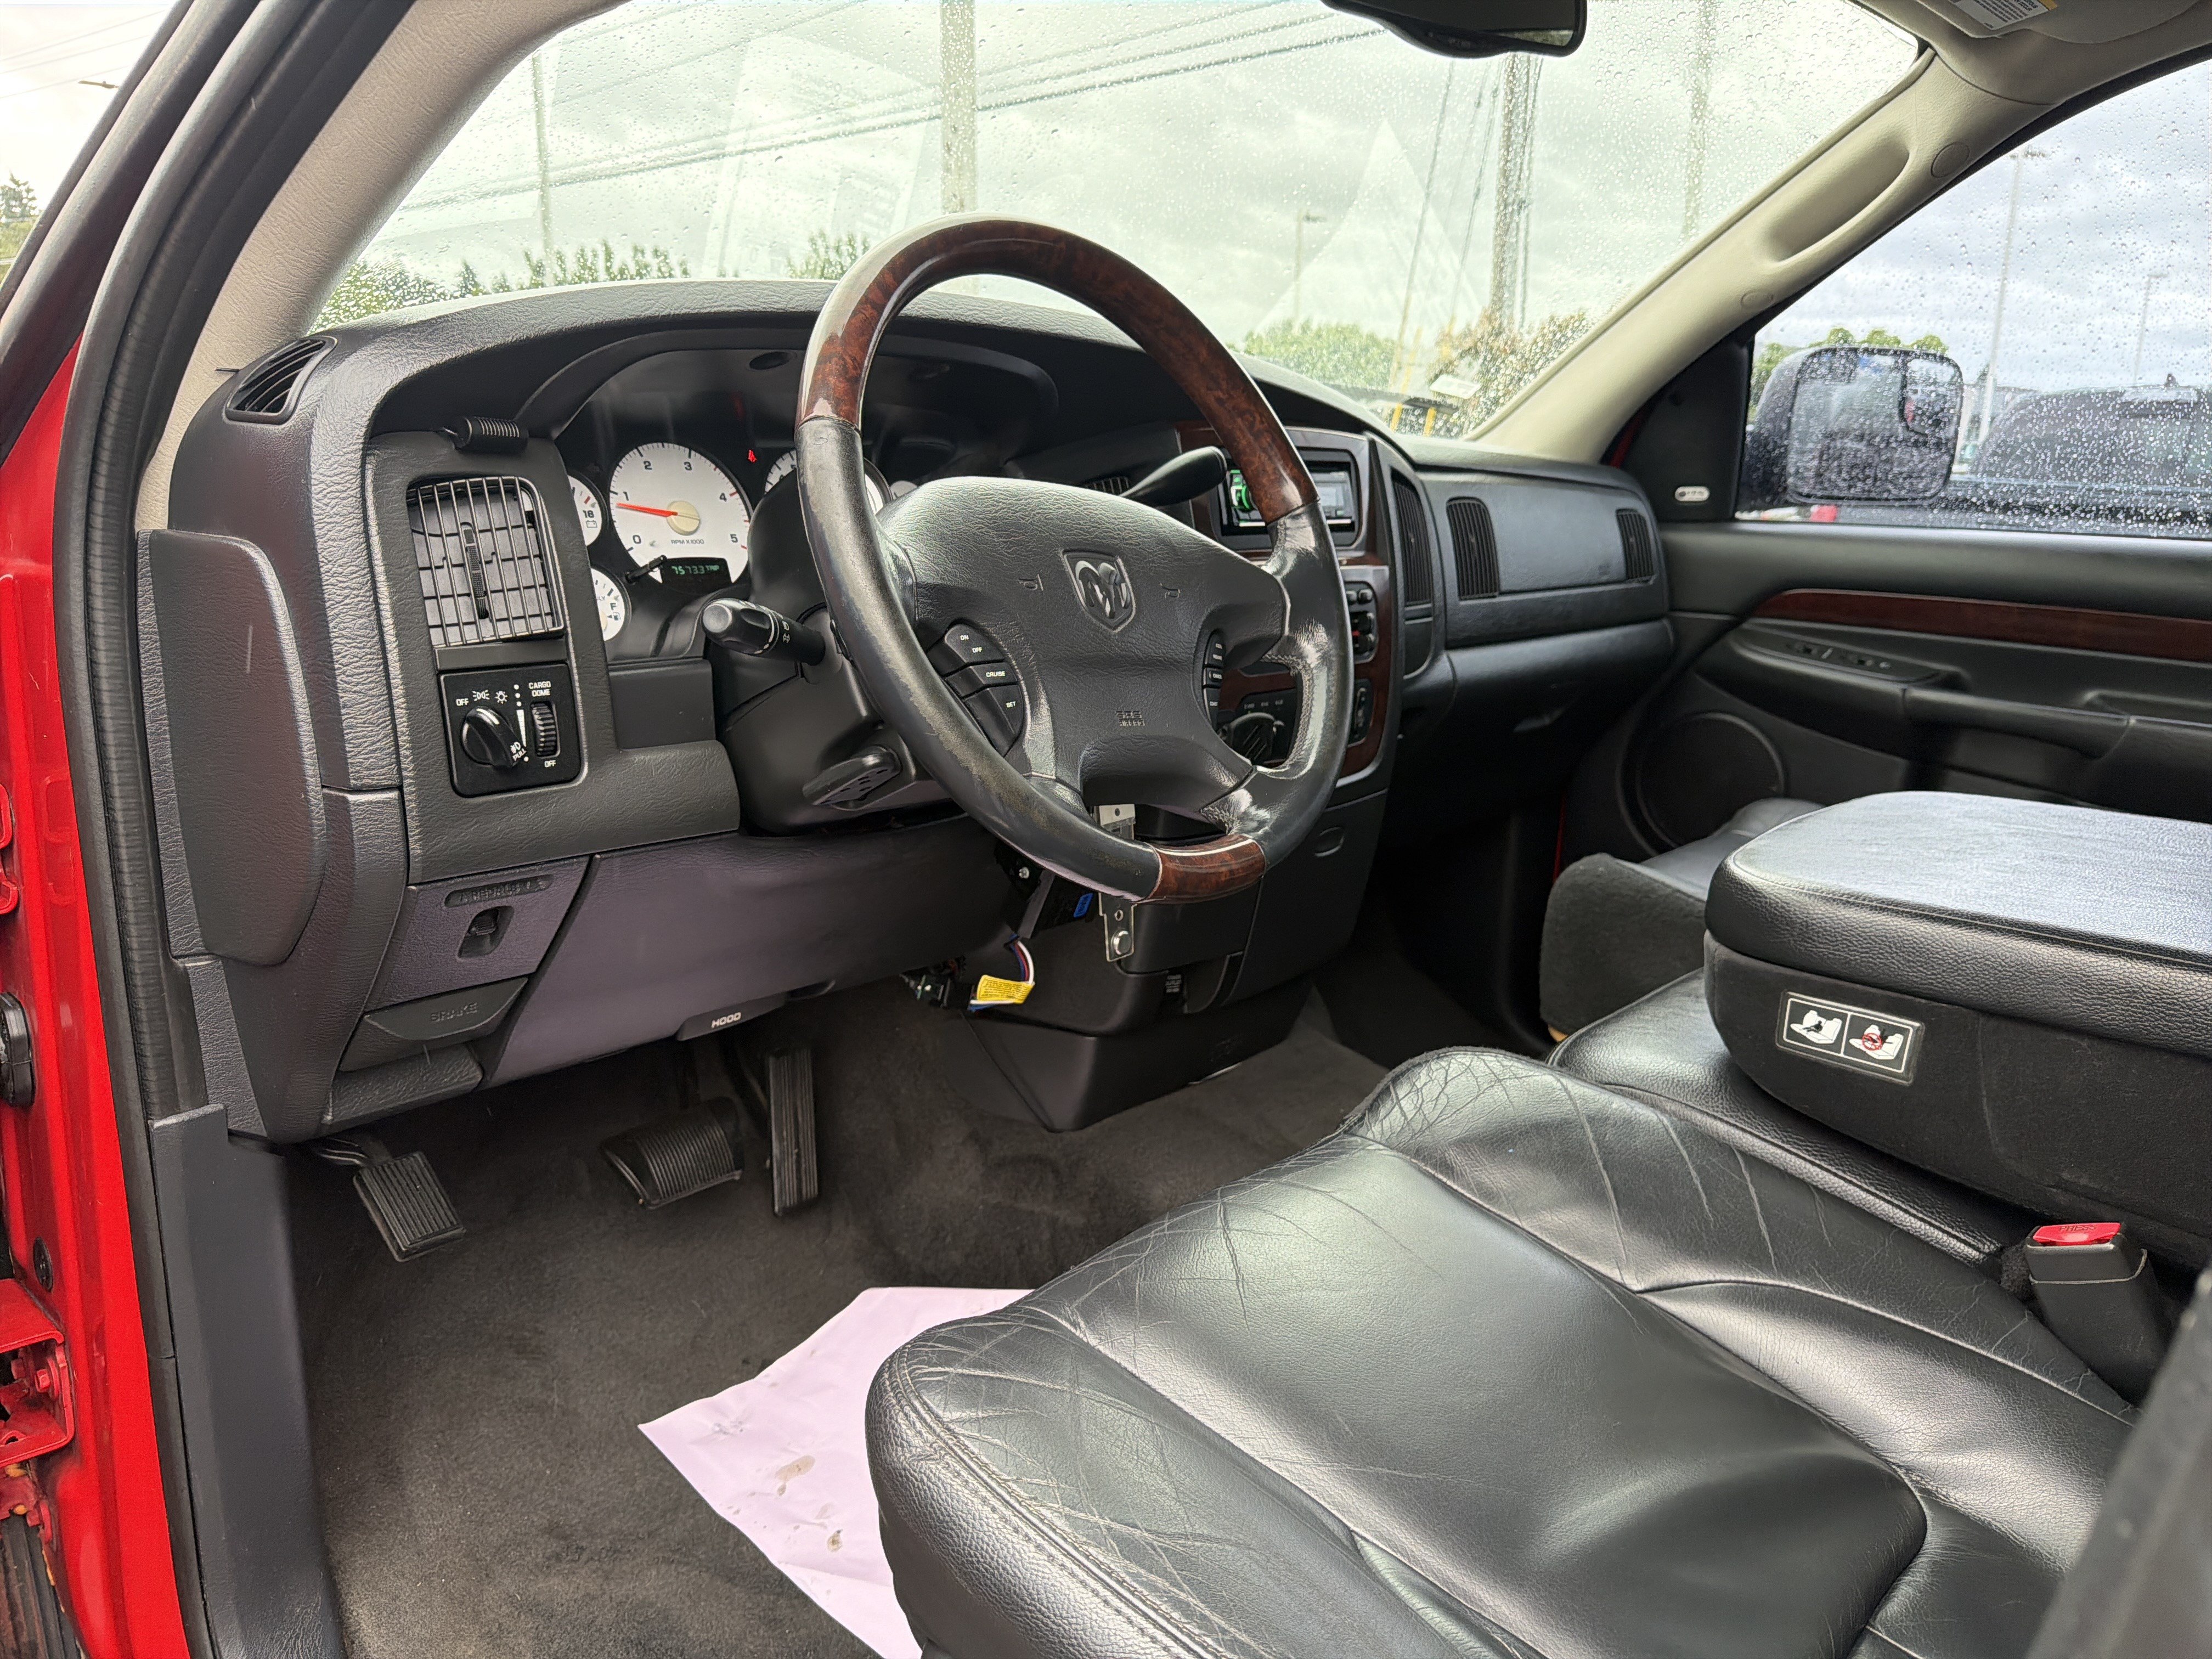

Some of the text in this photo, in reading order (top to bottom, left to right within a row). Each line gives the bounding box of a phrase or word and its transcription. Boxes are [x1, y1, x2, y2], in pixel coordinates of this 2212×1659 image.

[644, 461, 652, 470] 2
[684, 461, 692, 471] 3
[623, 492, 629, 500] 1
[719, 493, 727, 502] 4
[583, 510, 594, 518] 18
[633, 535, 641, 544] 0
[730, 534, 738, 543] 5
[529, 681, 551, 690] CARGO
[512, 748, 527, 761] PULL
[712, 1012, 741, 1028] HOOD
